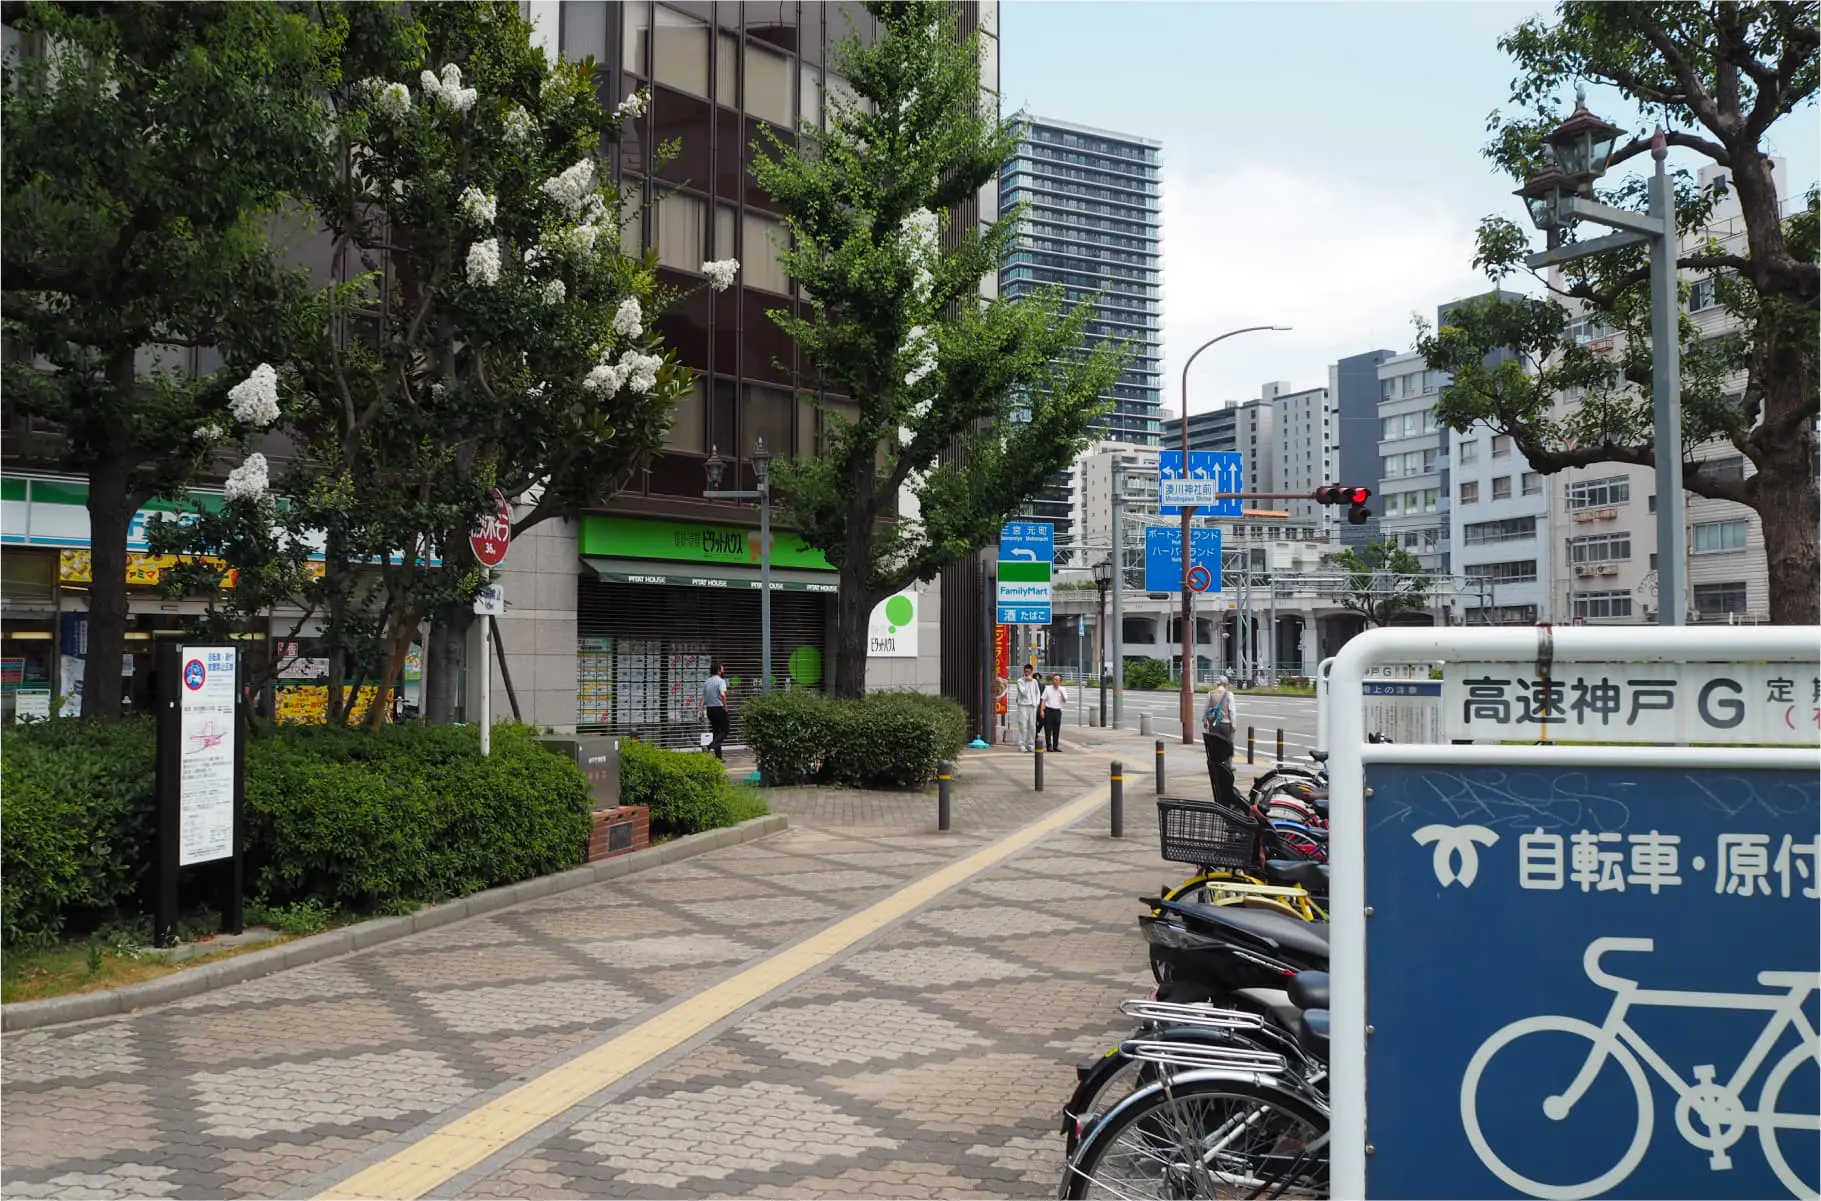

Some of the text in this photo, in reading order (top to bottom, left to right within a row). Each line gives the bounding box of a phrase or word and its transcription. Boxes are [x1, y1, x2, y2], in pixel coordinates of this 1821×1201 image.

[1166, 484, 1211, 495] 湊川神社前
[1027, 525, 1047, 536] 元町
[1148, 529, 1218, 540] ポートアランド
[703, 530, 743, 554] ピタットハウス
[1152, 546, 1215, 557] ハーバランド
[628, 575, 666, 584] PITAT HOUSE
[692, 578, 707, 586] PITAT
[1000, 586, 1048, 596] FamilyMart
[1021, 611, 1046, 620] たばこ
[1383, 667, 1391, 676] G
[1462, 675, 1678, 728] 高速神戸
[1697, 677, 1746, 729] G
[1518, 827, 1820, 897] 自転車・原付
